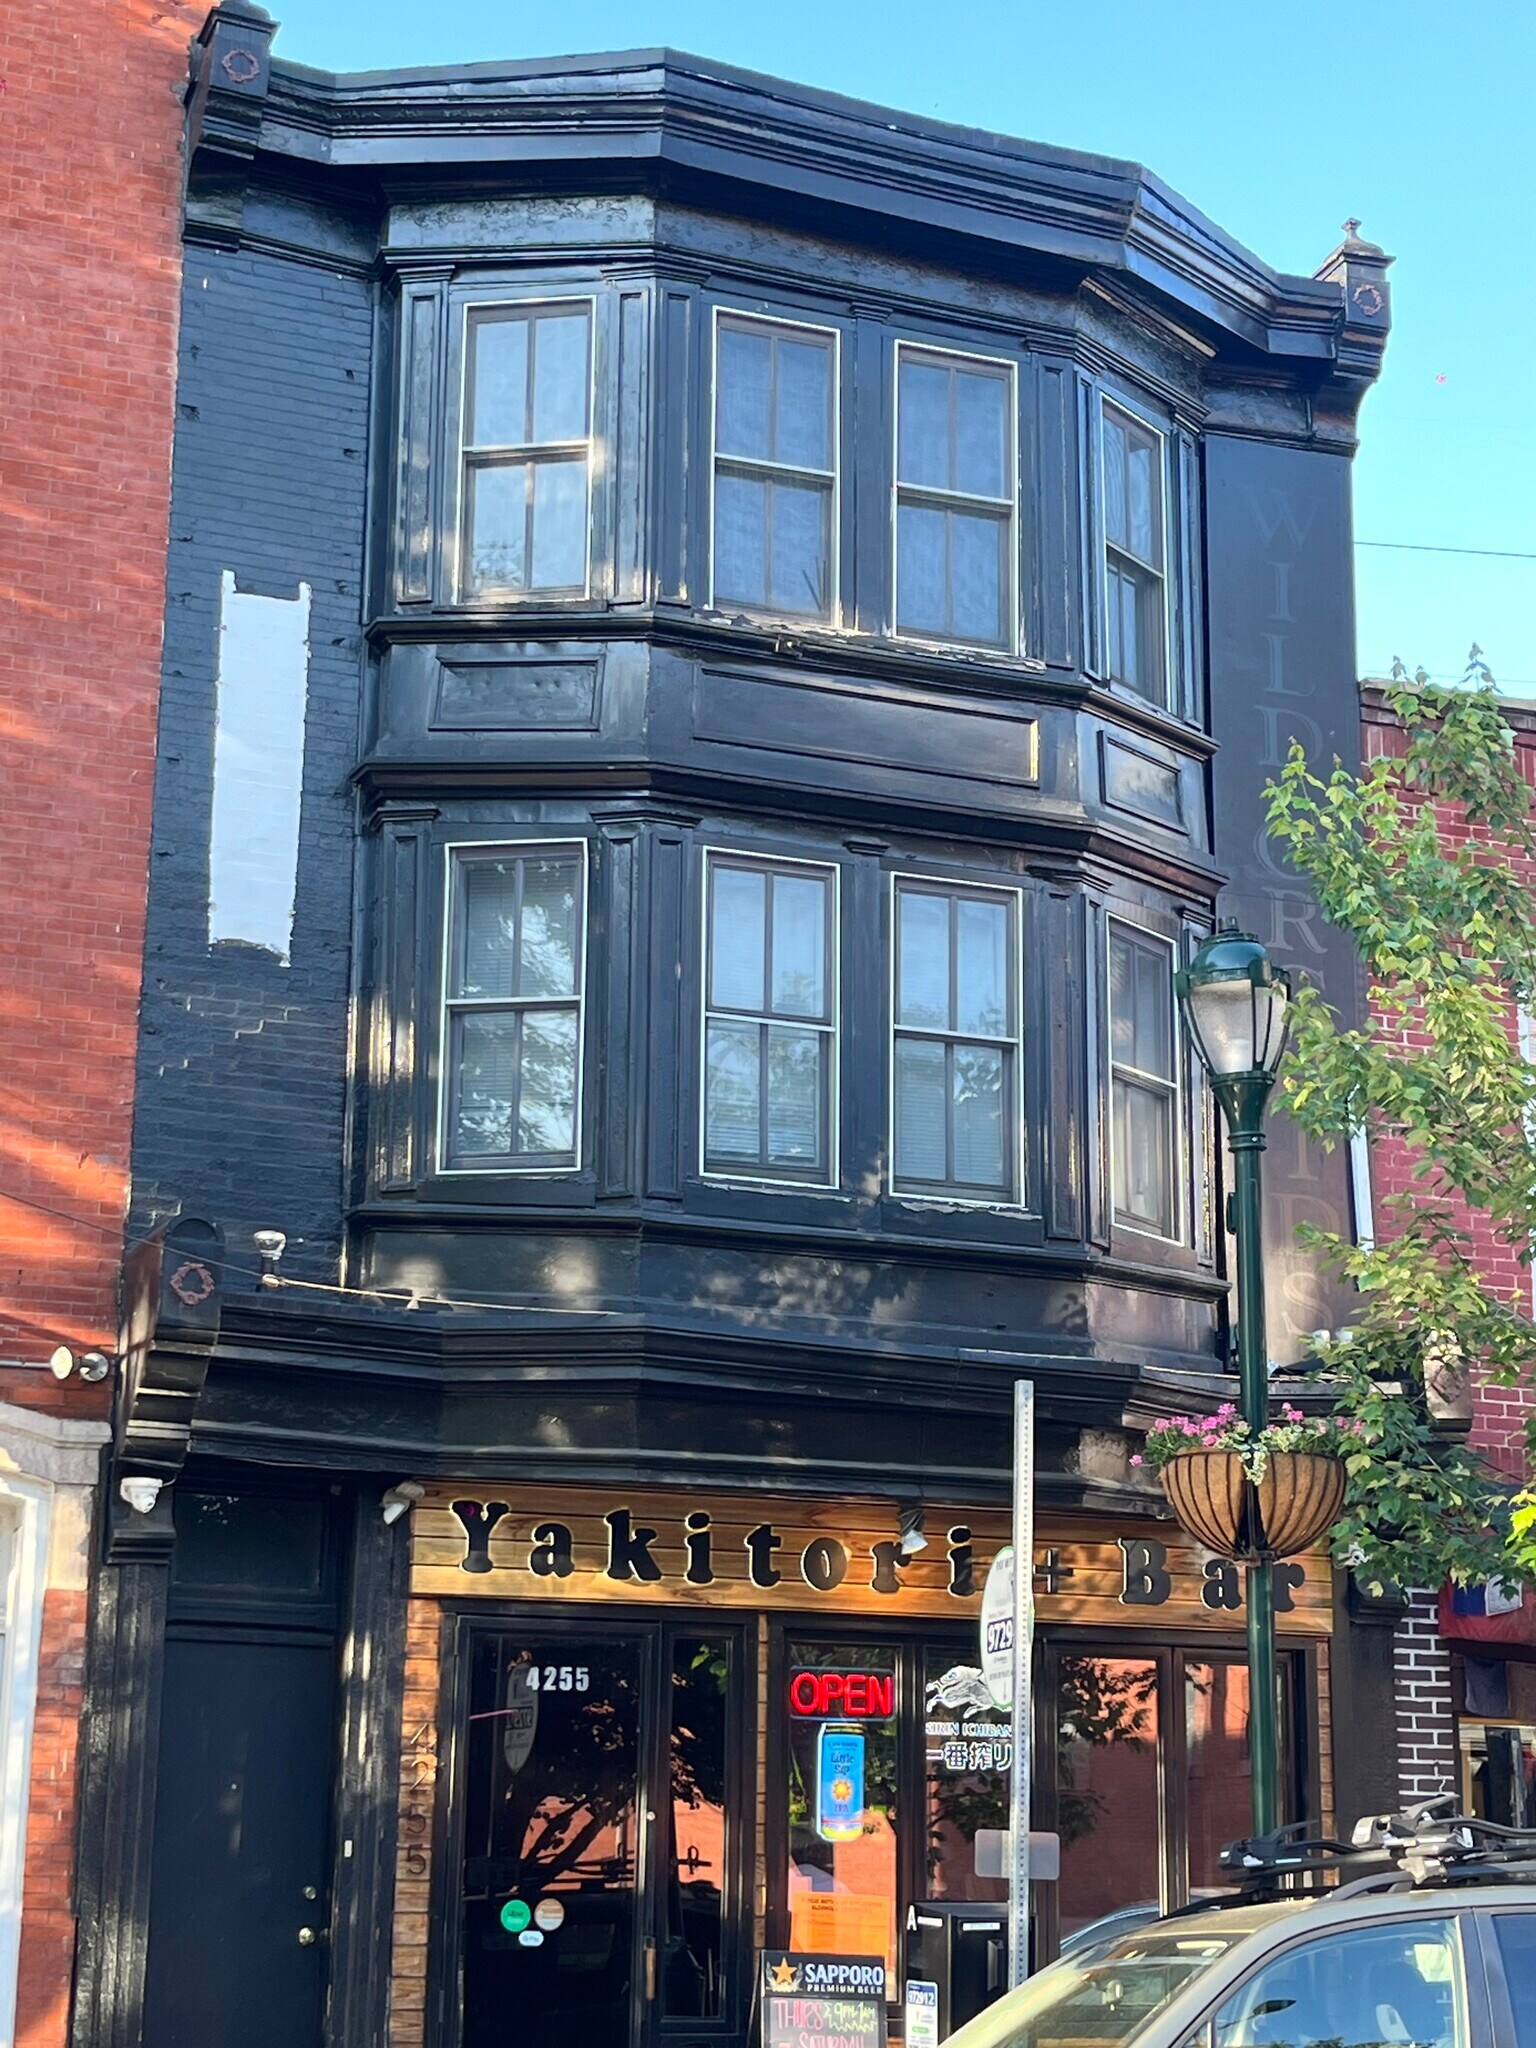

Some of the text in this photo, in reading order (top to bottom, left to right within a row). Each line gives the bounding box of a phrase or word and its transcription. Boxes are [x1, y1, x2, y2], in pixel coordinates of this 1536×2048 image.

[449, 1499, 977, 1597] Yakitori
[1118, 1537, 1305, 1613] Bar
[526, 1666, 590, 1692] 4255
[791, 1672, 893, 1716] OPEN
[407, 1723, 431, 1875] 4255
[804, 1963, 884, 1986] SAPPORO
[807, 1983, 883, 1994] PREMIUM BEER
